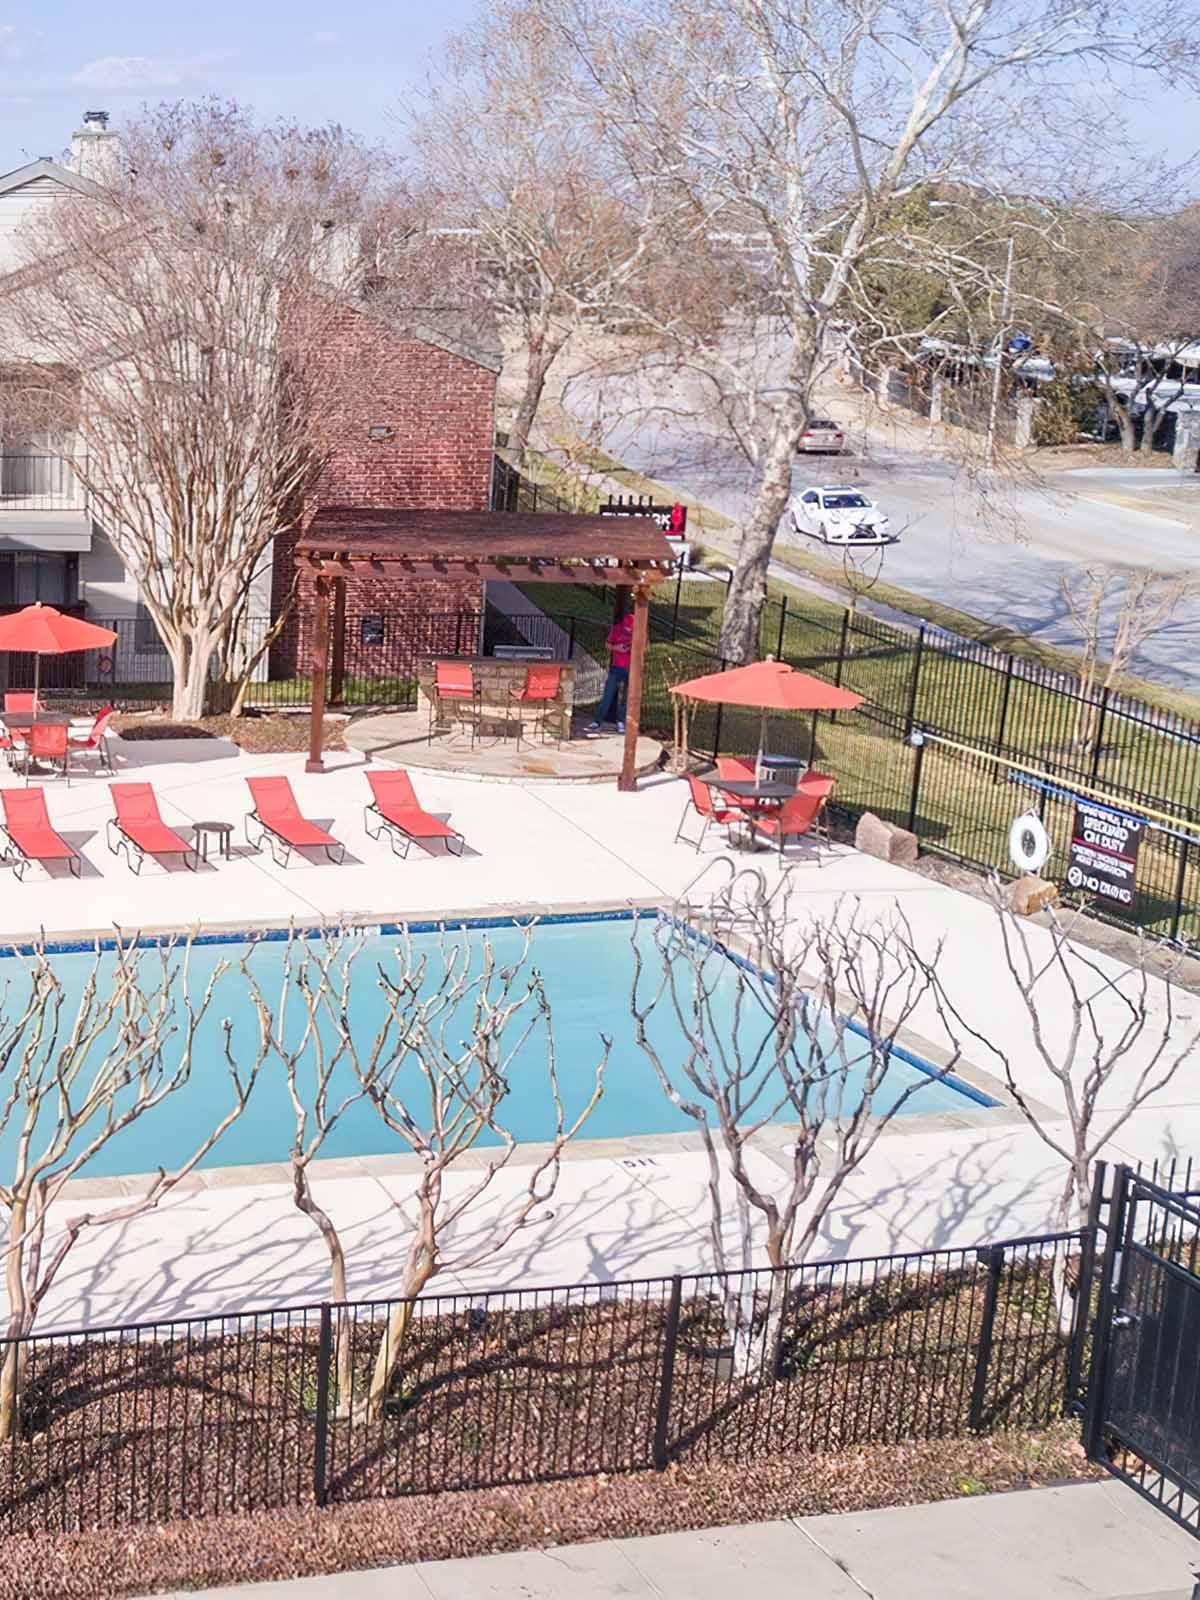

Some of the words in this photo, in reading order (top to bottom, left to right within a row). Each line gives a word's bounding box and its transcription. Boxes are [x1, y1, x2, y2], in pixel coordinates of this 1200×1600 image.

[1083, 830, 1100, 845] ON
[1101, 835, 1125, 853] DUTY
[1082, 874, 1099, 891] NO
[1100, 881, 1131, 903] DIVING
